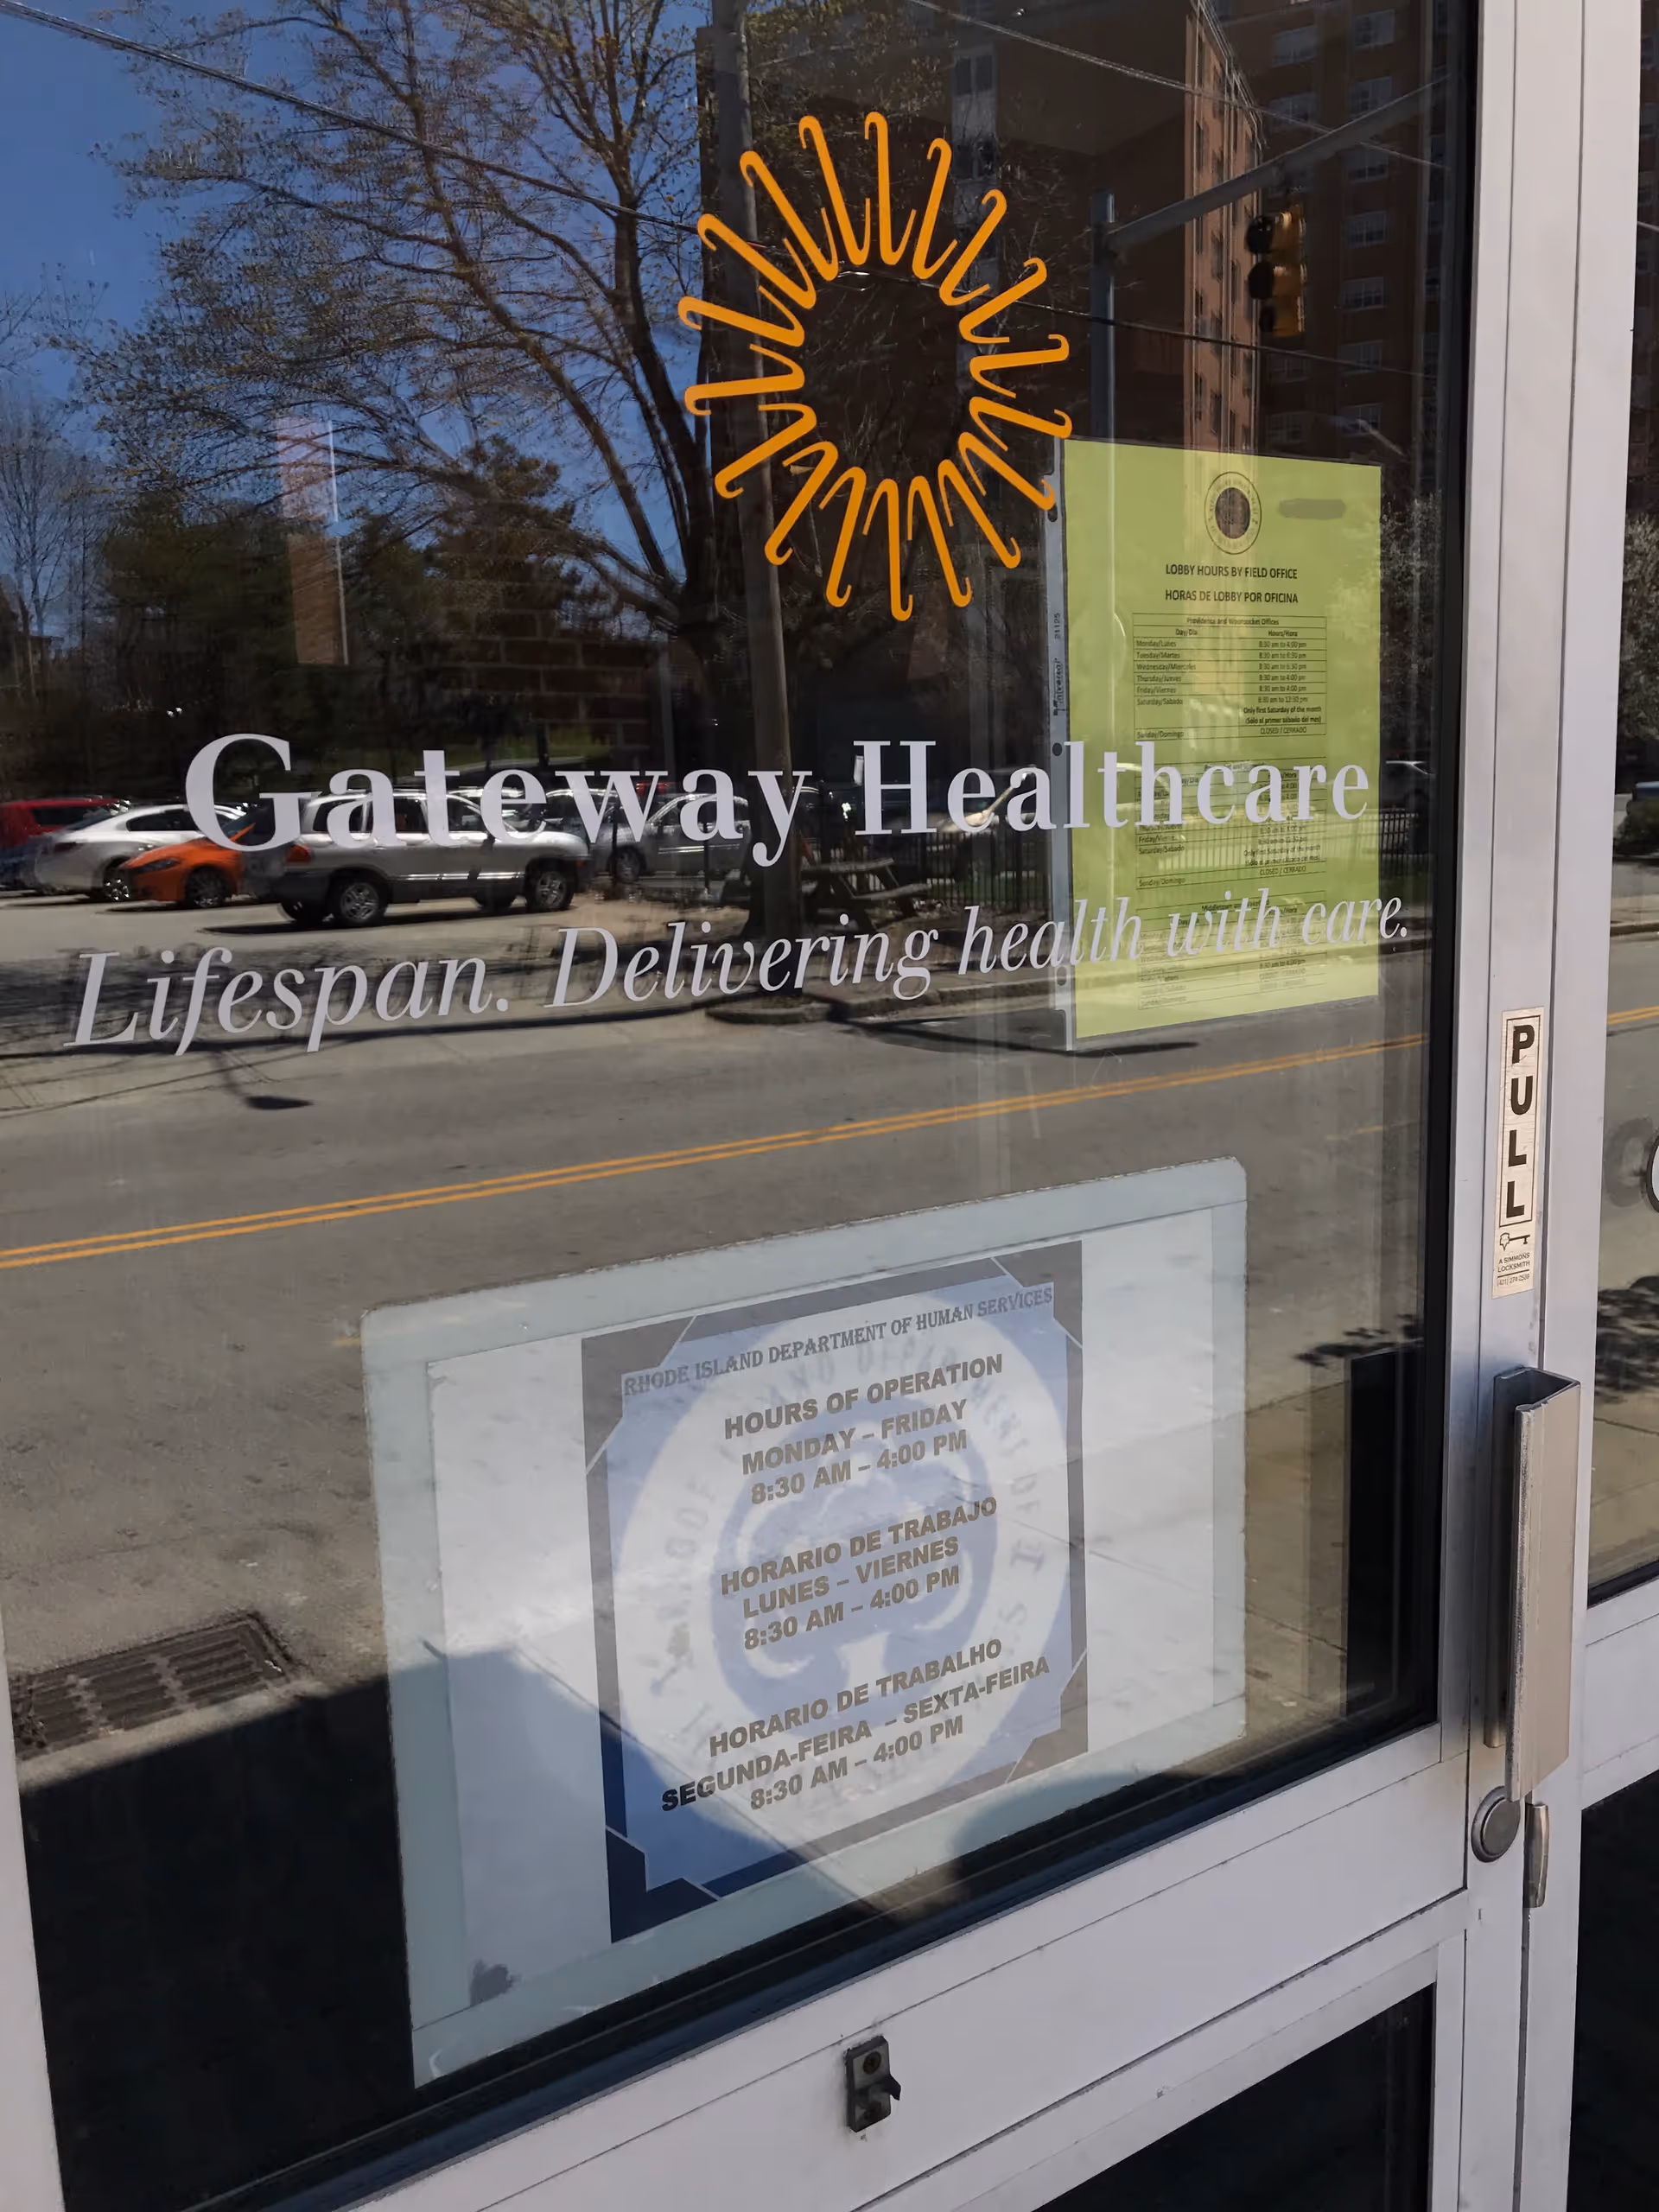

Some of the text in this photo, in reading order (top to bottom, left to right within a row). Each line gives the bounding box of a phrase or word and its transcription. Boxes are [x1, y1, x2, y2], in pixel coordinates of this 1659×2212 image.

[1165, 589, 1299, 604] HORAS DE LOBBY POR OFICINA
[1166, 563, 1298, 580] LOBBY HOURS BY FIELD OFFICE
[185, 733, 1370, 866] Gateway Healthcare
[64, 945, 512, 1055] Lifespan.
[543, 921, 938, 1001] Delivering
[958, 897, 1143, 976] health
[1168, 887, 1283, 957] with
[1301, 896, 1408, 946] care.
[1505, 1024, 1536, 1219] PULL
[1497, 1260, 1530, 1273] LOCKSMITH
[1503, 1253, 1530, 1263] SIMMONS
[623, 1365, 689, 1396] RHODE
[695, 1350, 763, 1379] ISLAND
[768, 1315, 887, 1363] DEPARTMENT
[890, 1315, 912, 1336] OF
[916, 1304, 974, 1331] HUMAN
[977, 1287, 1052, 1318] SERVICES
[724, 1399, 818, 1440] HOURS
[827, 1388, 859, 1414] OF
[867, 1353, 1003, 1403] OPERATION
[741, 1427, 856, 1475] MONDAY
[881, 1399, 967, 1441] FRIDAY
[751, 1473, 804, 1505] 8:30
[813, 1459, 852, 1490] AM
[877, 1442, 926, 1471] 4:00
[933, 1429, 968, 1455] PM
[721, 1497, 997, 1595] HORARIO DE TRABAJO
[743, 1575, 830, 1618] LUNES
[856, 1535, 959, 1583] VIERNES
[744, 1616, 798, 1650] 8:30
[806, 1603, 844, 1631] AM
[870, 1580, 919, 1610] 4:00
[927, 1566, 960, 1592] PM
[662, 1719, 872, 1811] SEGUNDA-FEIRA
[904, 1656, 1050, 1724] SEXTA-FEIRA
[709, 1638, 1002, 1757] HORARIO DE TRABALHO
[751, 1774, 804, 1810] 8:30
[810, 1759, 848, 1789] AM
[874, 1730, 923, 1762] 4:00
[931, 1715, 963, 1743] PM
